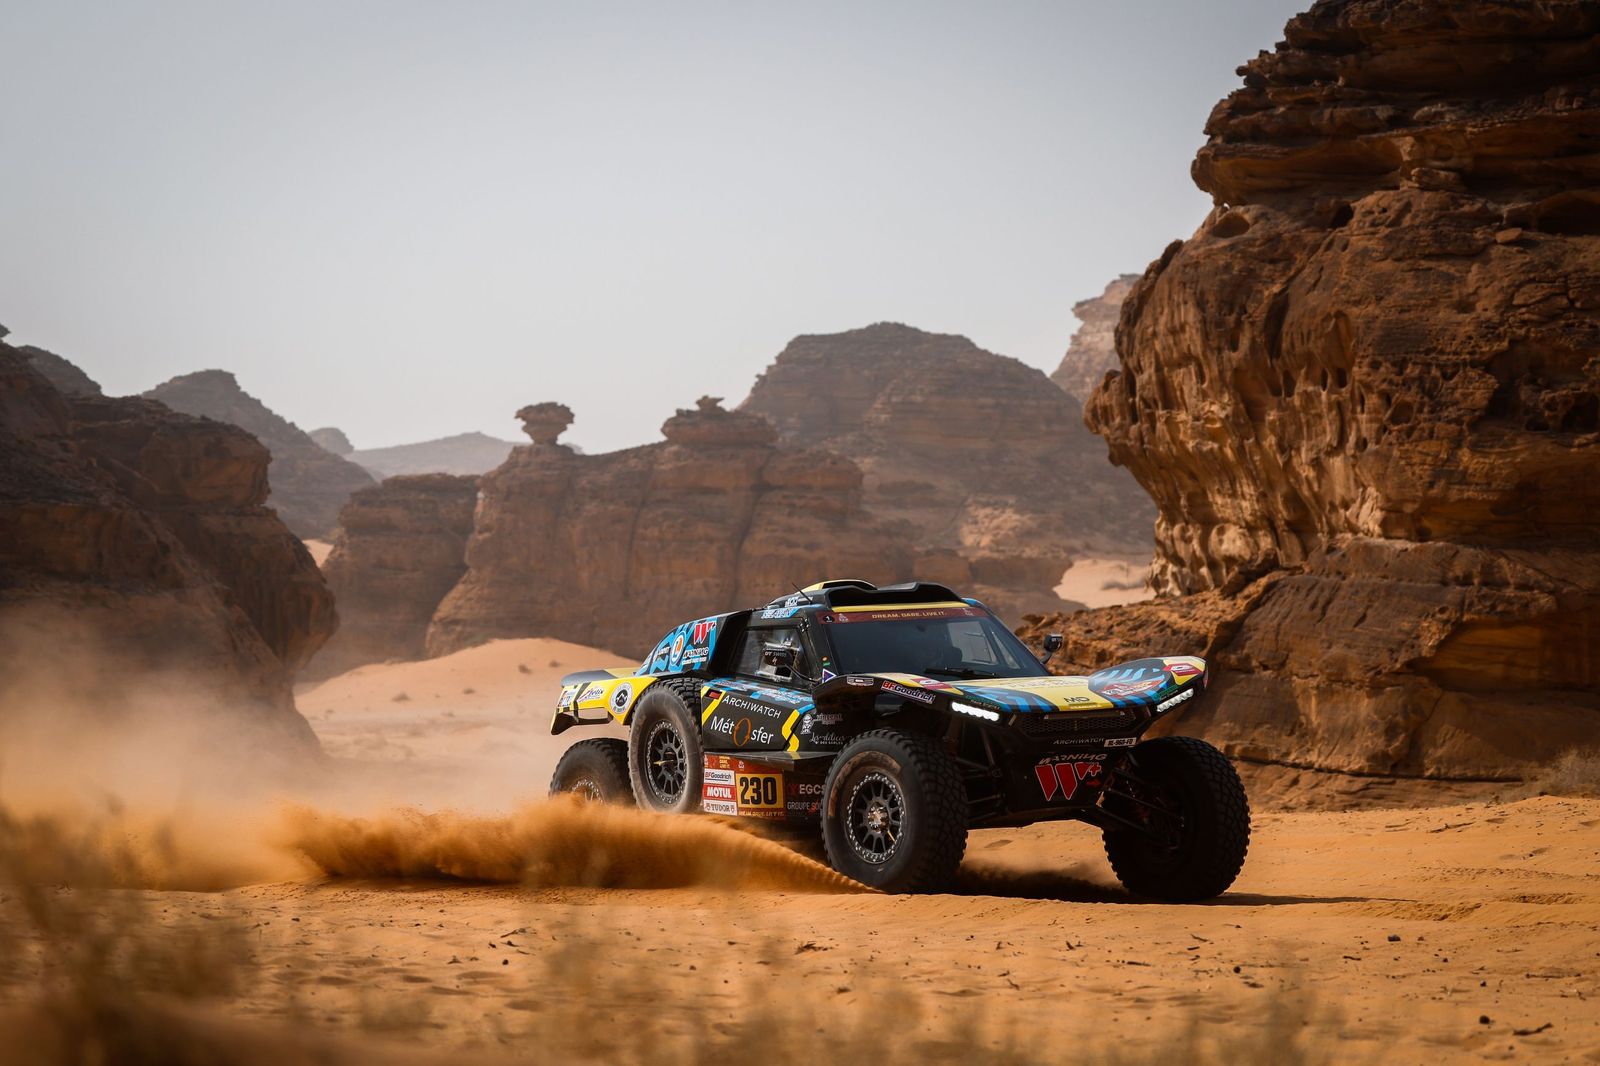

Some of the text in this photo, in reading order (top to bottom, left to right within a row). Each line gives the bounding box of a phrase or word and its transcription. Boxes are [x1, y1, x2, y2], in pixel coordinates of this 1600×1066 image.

[882, 680, 934, 702] BFGoodrich
[722, 695, 782, 718] ARCHIWATCH
[705, 772, 732, 780] BFGoodrich
[706, 786, 732, 798] MOTUL
[740, 776, 778, 805] 230
[711, 803, 730, 812] TUDOR
[787, 802, 810, 810] GROUPE
